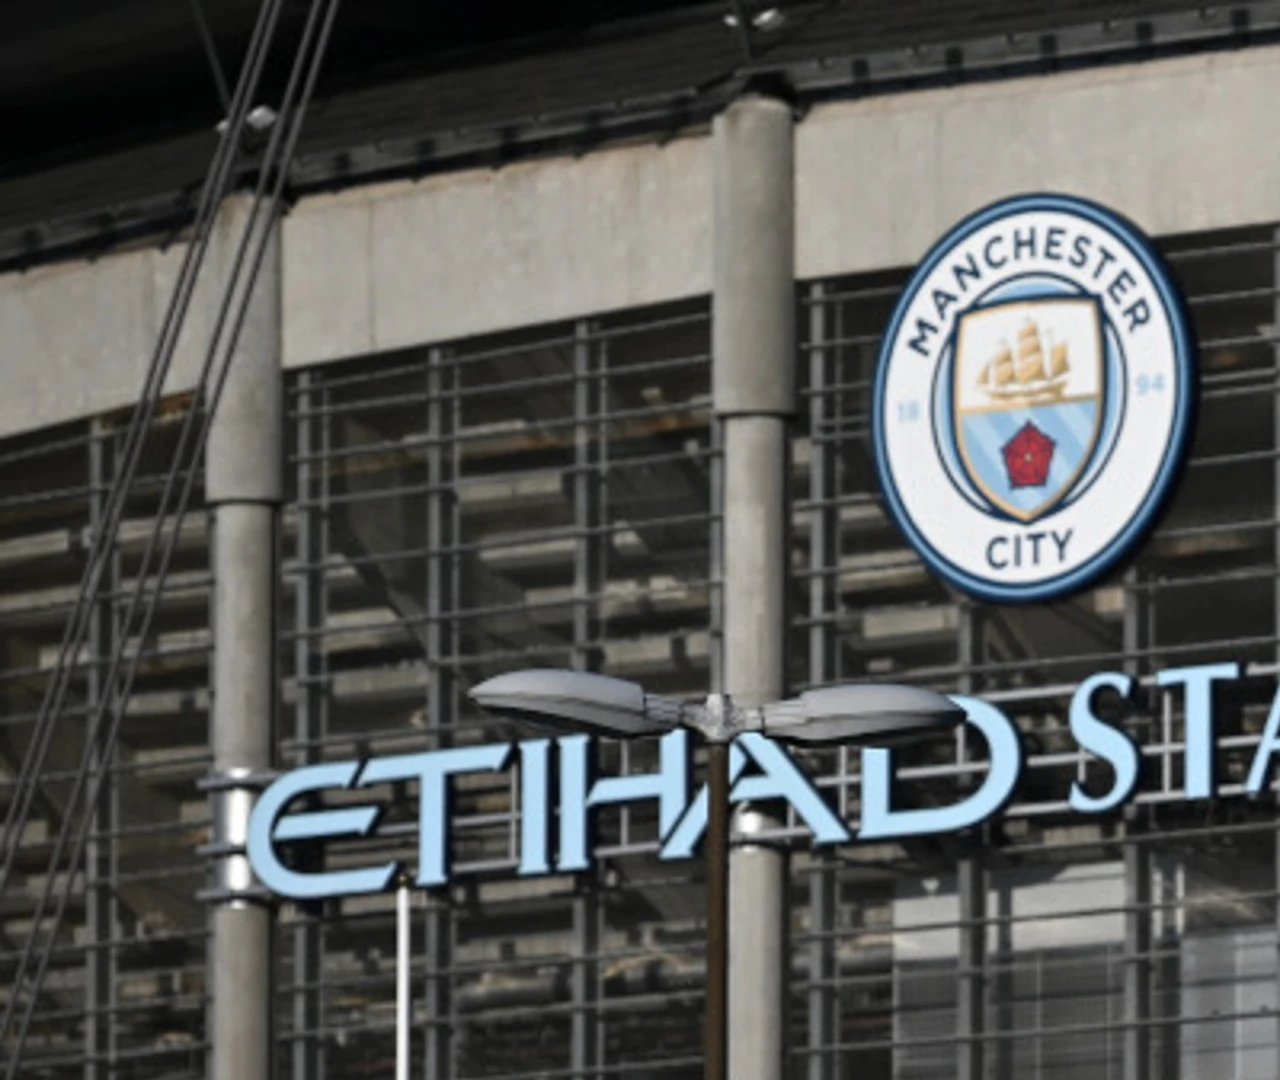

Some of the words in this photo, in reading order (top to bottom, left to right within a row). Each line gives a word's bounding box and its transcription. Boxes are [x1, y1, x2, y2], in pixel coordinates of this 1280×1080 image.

[907, 226, 1151, 358] MANCHESTER
[1136, 374, 1165, 395] 94
[986, 529, 1074, 570] CITY
[246, 694, 1022, 899] ETIHAD
